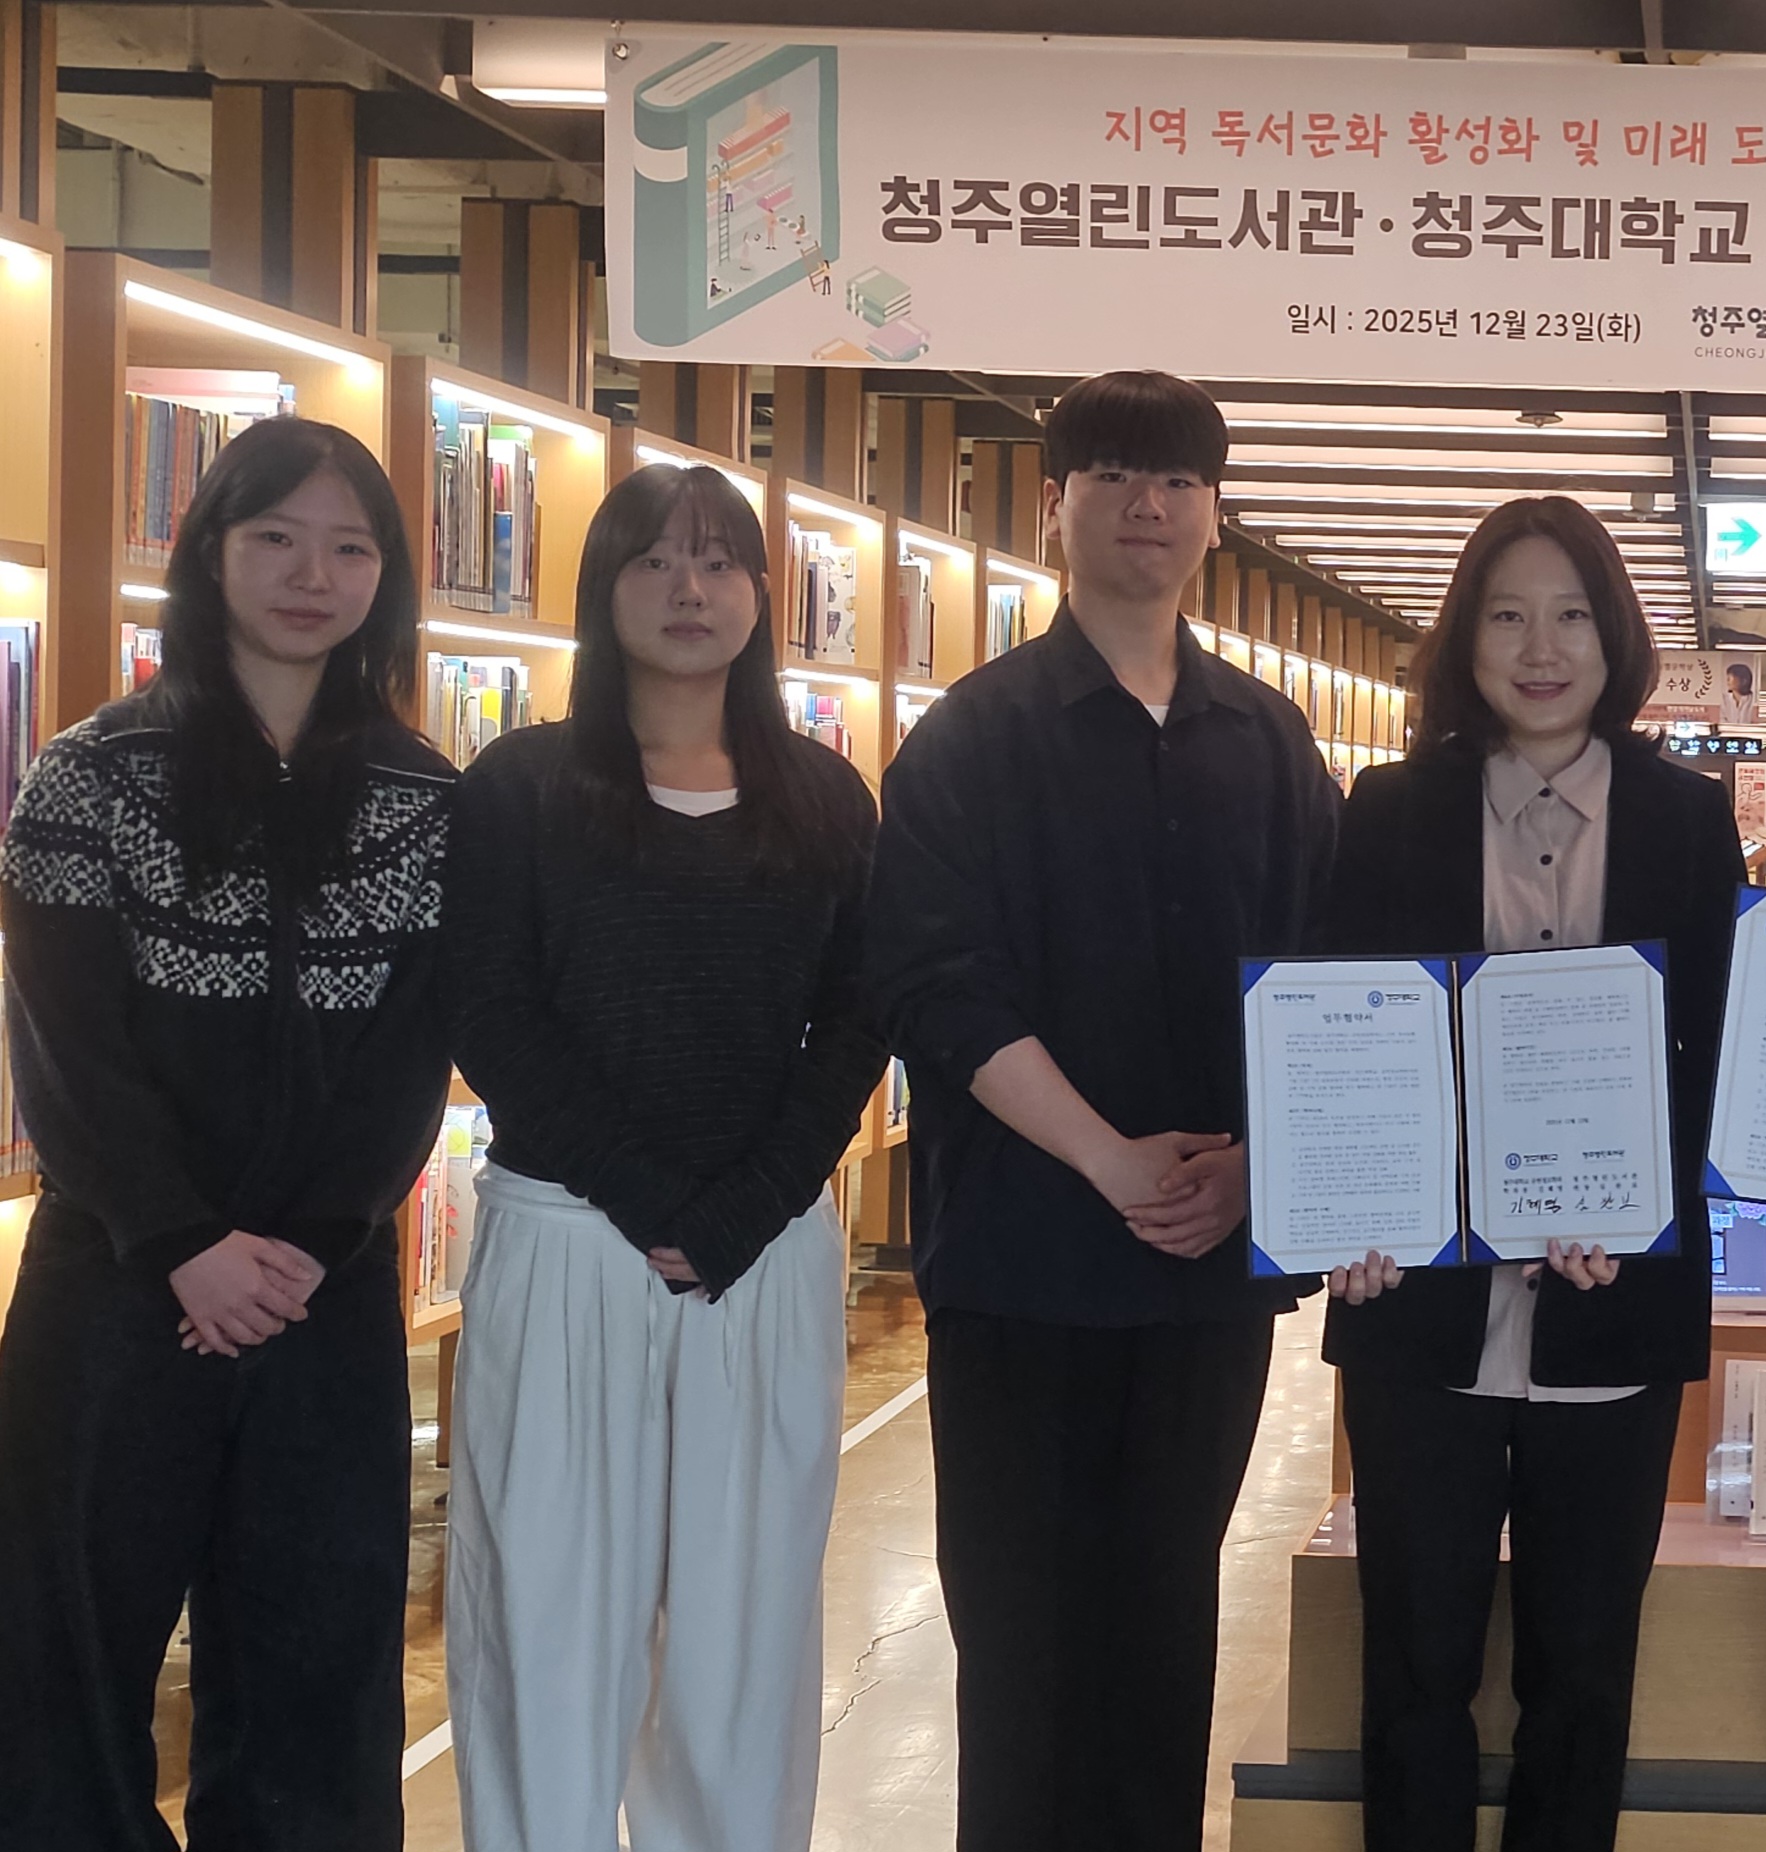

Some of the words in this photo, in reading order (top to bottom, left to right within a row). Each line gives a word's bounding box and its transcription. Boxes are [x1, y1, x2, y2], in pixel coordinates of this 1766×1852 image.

[1104, 106, 1187, 155] 지역
[1211, 109, 1388, 159] 독서문화
[1407, 111, 1541, 165] 활성화
[1562, 118, 1599, 167] 및
[1623, 120, 1708, 167] 미래
[1287, 303, 1336, 334] 일시
[1364, 308, 1458, 337] 2025년
[1470, 310, 1527, 340] 12월
[1535, 312, 1641, 344] 23일(화)
[1665, 677, 1691, 692] 수상
